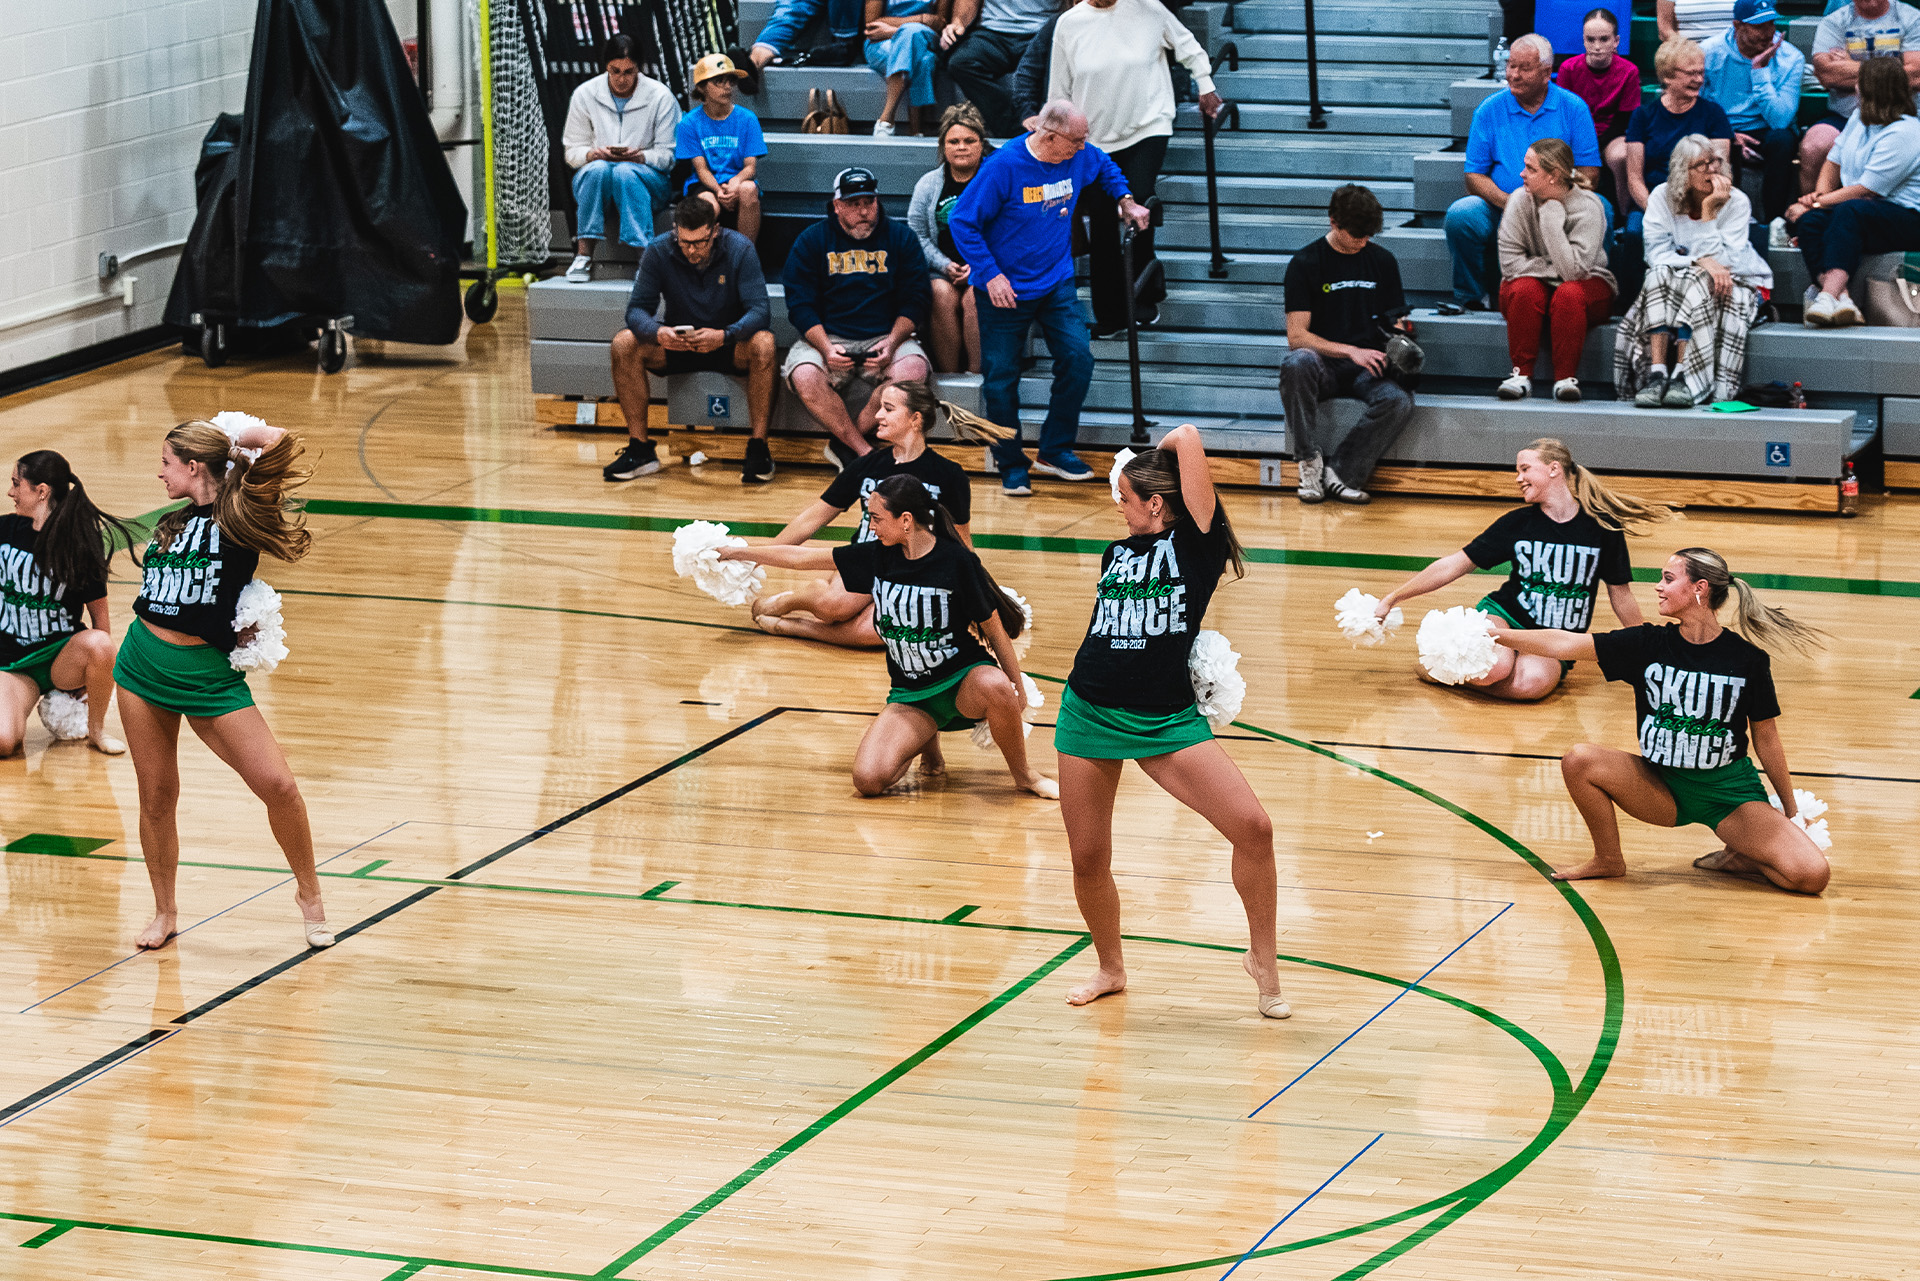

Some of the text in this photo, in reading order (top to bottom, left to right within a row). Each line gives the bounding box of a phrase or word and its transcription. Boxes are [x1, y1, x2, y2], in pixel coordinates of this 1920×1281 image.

[826, 249, 888, 276] MERCY
[147, 516, 220, 554] UTT
[0, 543, 67, 601] SKU
[140, 560, 222, 605] ANCE
[1097, 573, 1174, 600] Catholic
[1514, 540, 1601, 587] SKUTT
[875, 624, 960, 672] ANCE
[1110, 638, 1147, 650] 2026-2027
[1644, 662, 1746, 722] SKUTT
[1639, 714, 1737, 769] DANCE
